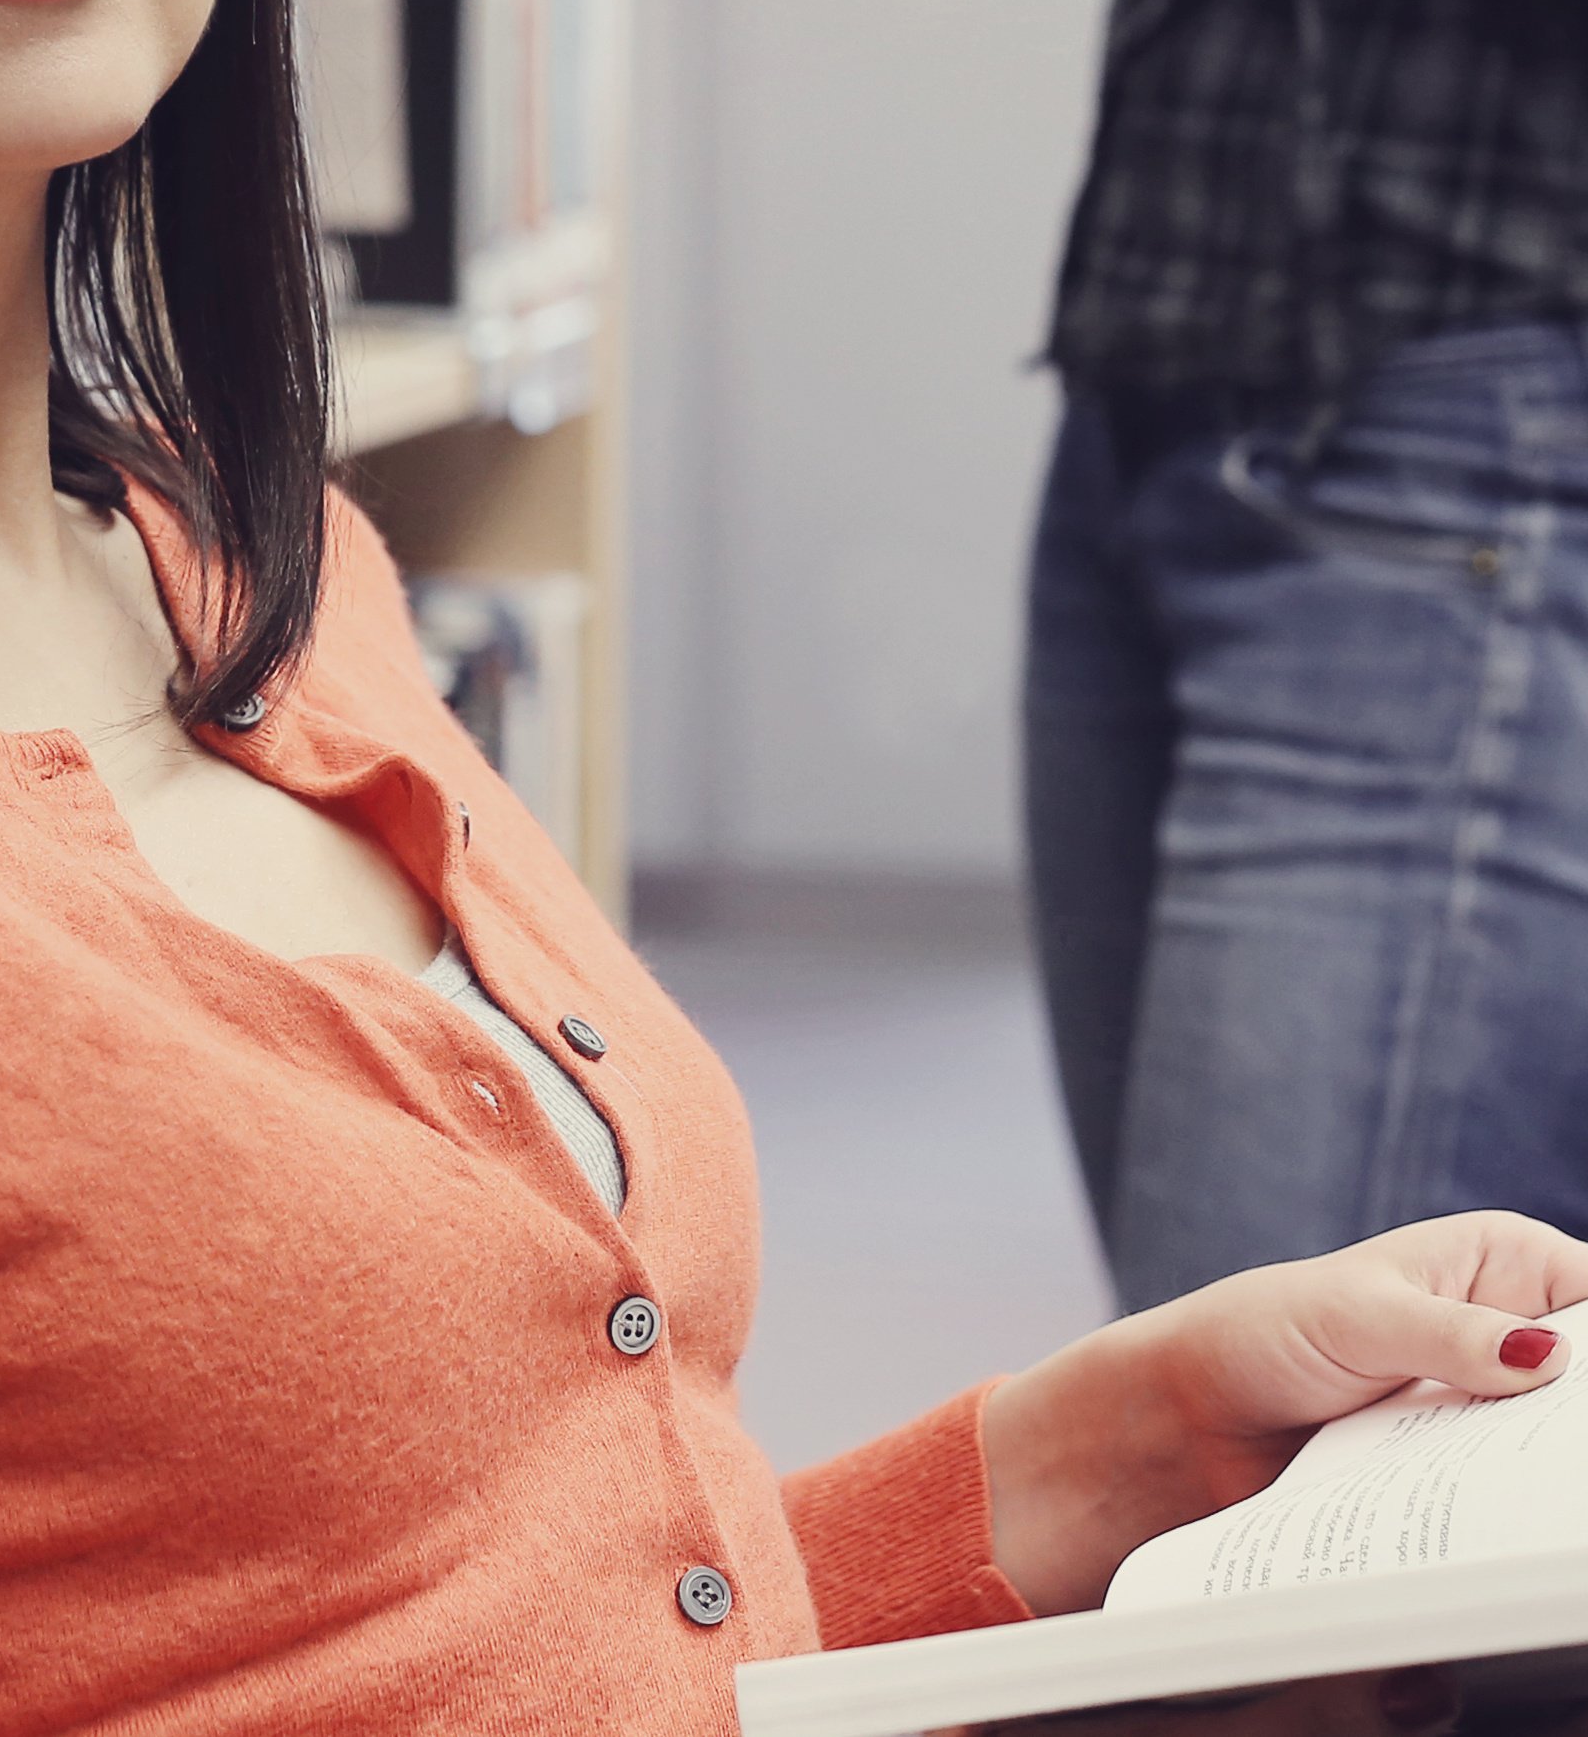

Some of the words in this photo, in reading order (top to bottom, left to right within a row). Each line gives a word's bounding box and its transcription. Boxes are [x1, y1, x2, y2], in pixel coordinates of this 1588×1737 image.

[1320, 1504, 1344, 1561] небрежно
[1364, 1510, 1377, 1529] что
[1396, 1529, 1409, 1566] хоро
[1319, 1568, 1332, 1581] б
